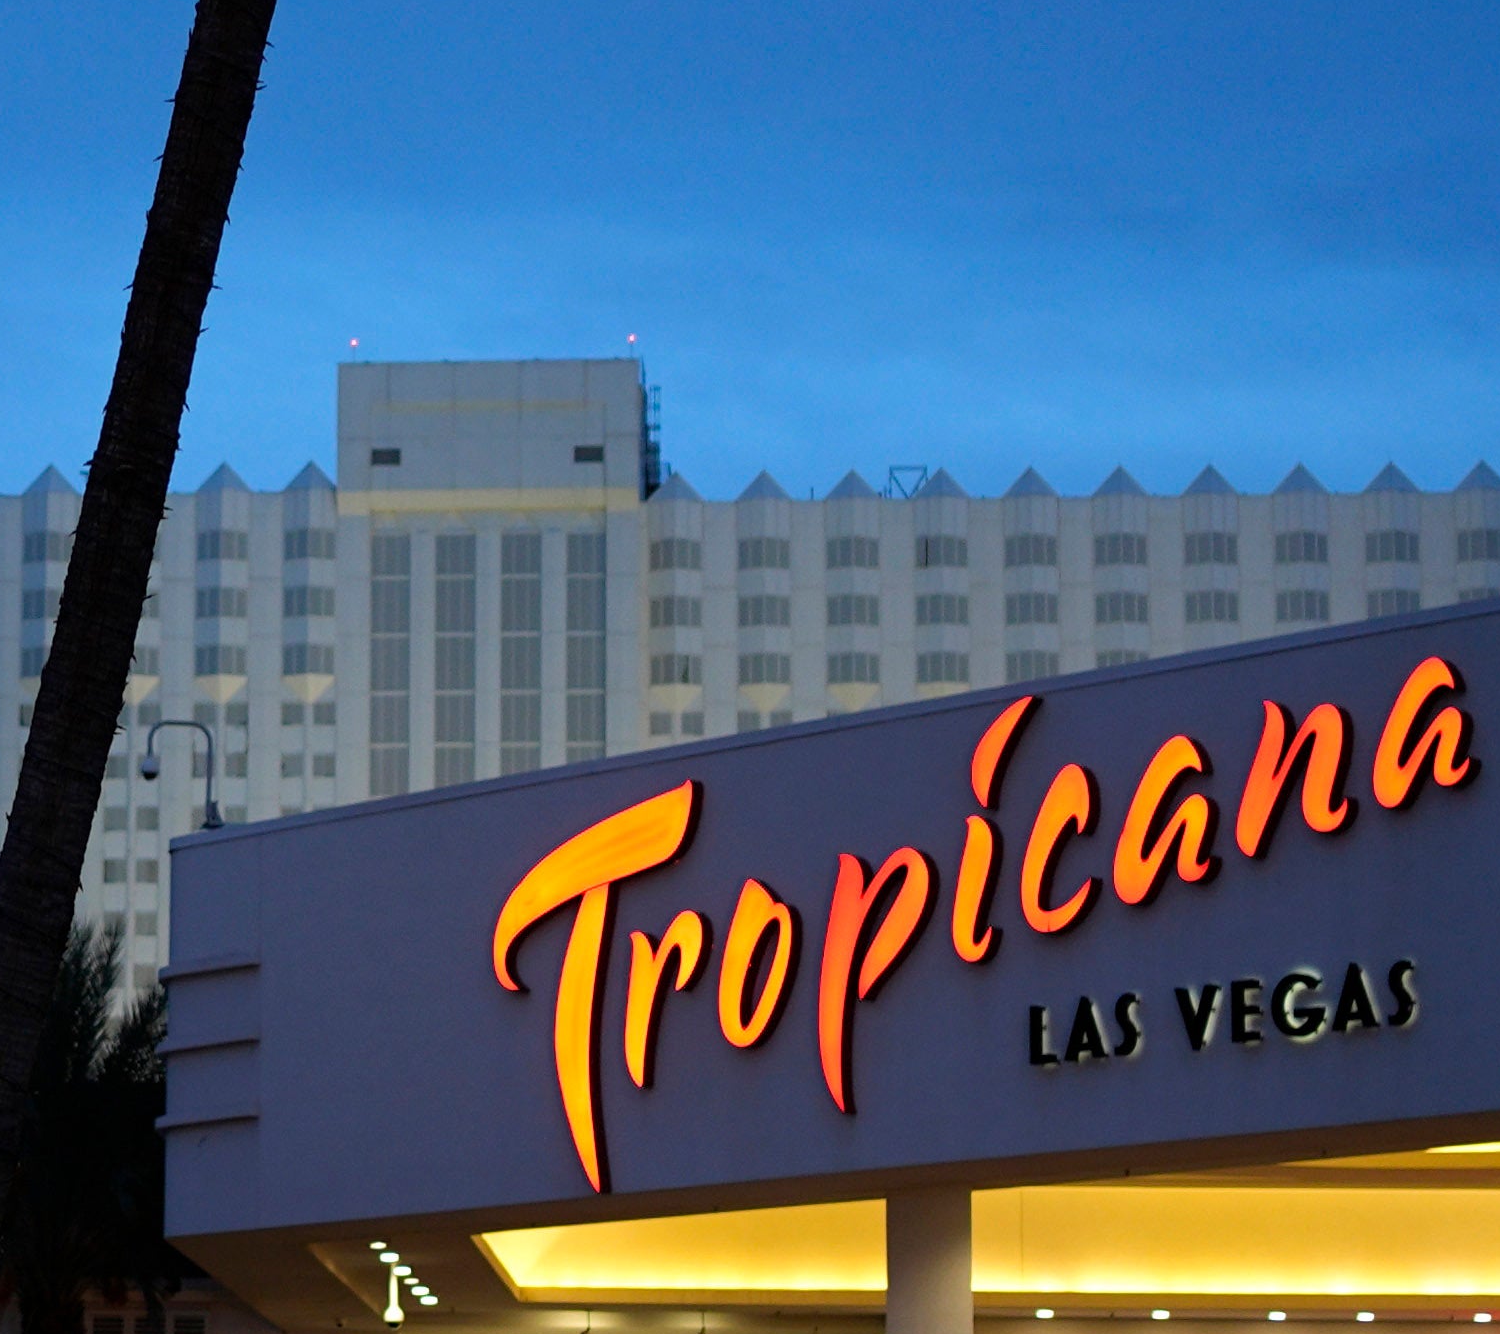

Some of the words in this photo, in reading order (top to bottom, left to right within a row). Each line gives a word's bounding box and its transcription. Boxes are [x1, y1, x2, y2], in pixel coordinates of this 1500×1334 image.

[492, 656, 1480, 1193] Tropicana
[1028, 989, 1143, 1067] LAS
[1174, 959, 1419, 1053] VEGAS
